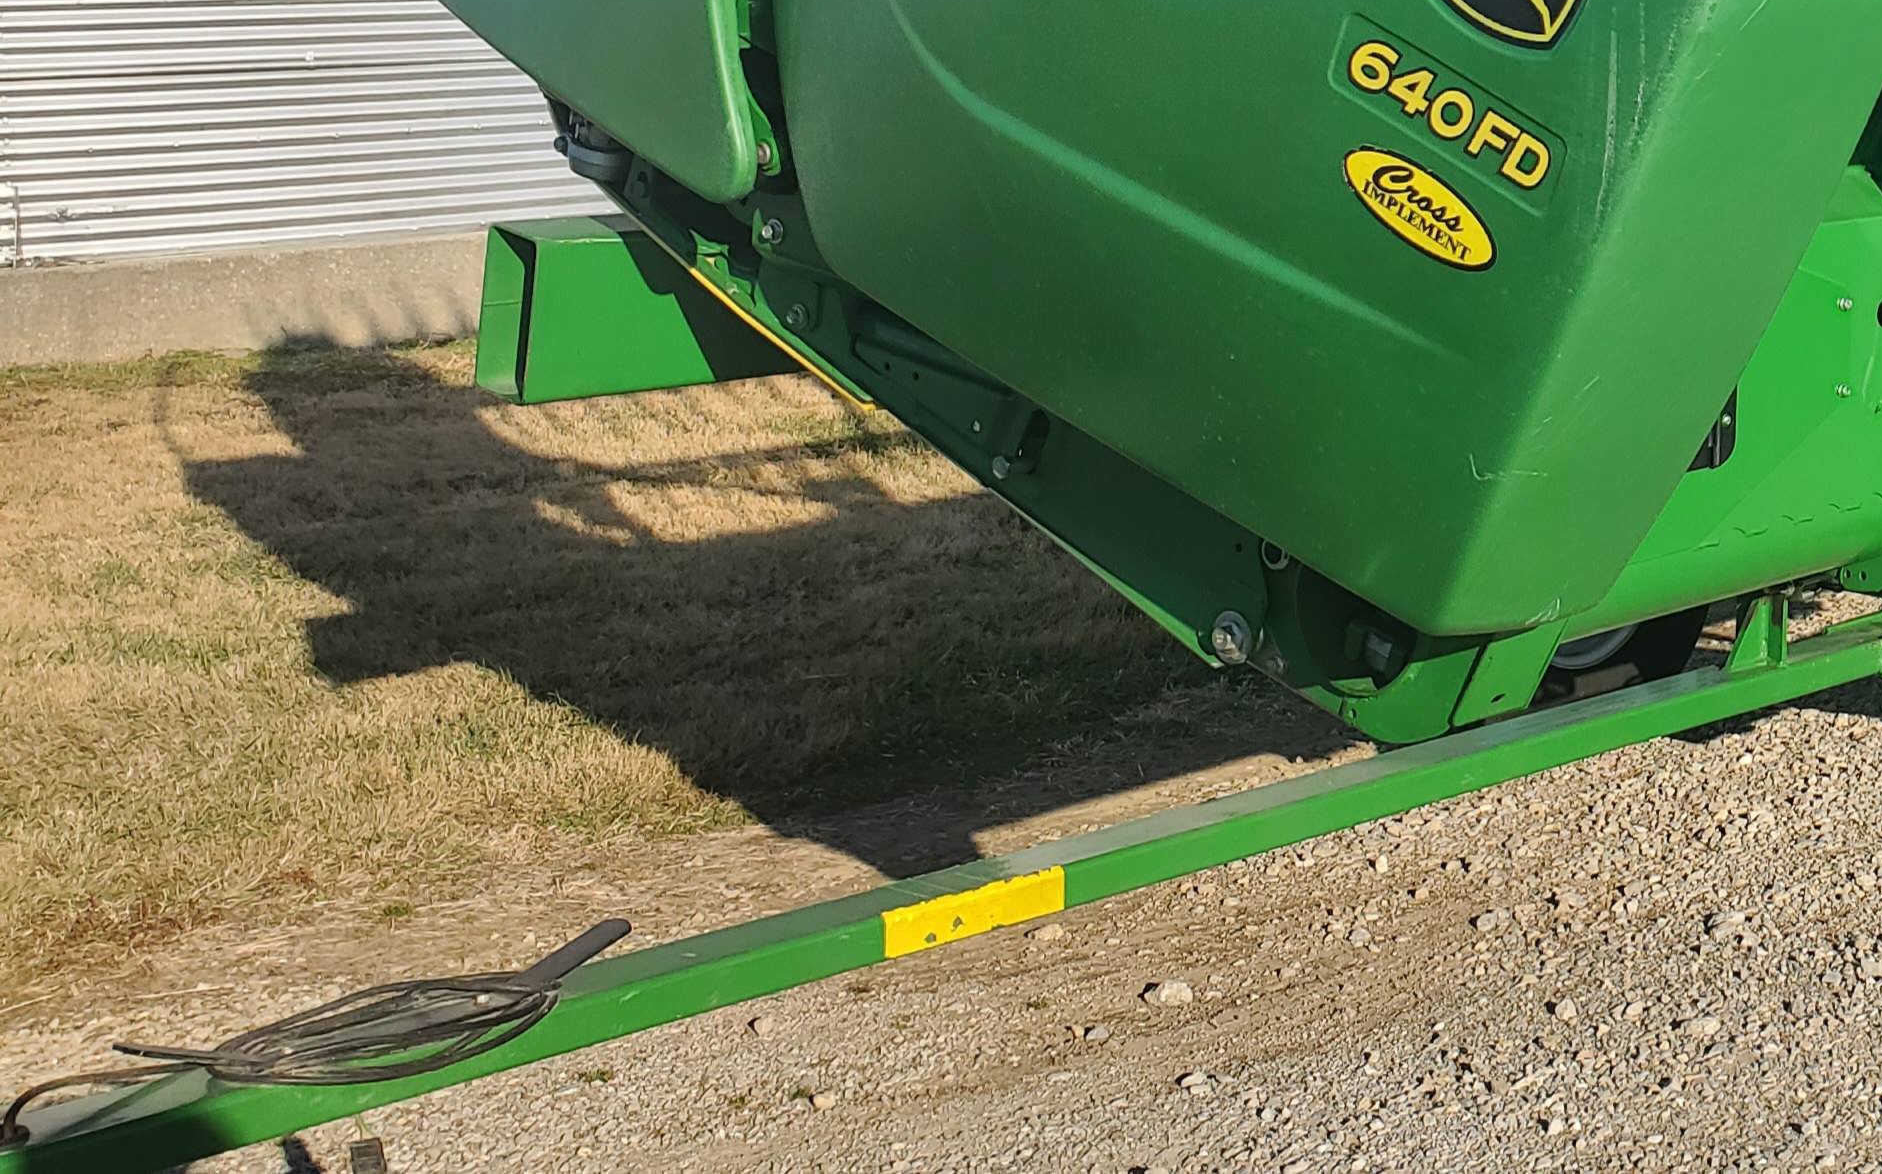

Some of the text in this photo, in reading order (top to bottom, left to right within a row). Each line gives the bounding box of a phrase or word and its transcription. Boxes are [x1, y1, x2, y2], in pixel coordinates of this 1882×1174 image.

[1348, 40, 1551, 191] 640FD
[1362, 179, 1471, 262] IMPLEMENT
[1372, 165, 1464, 232] Cross
